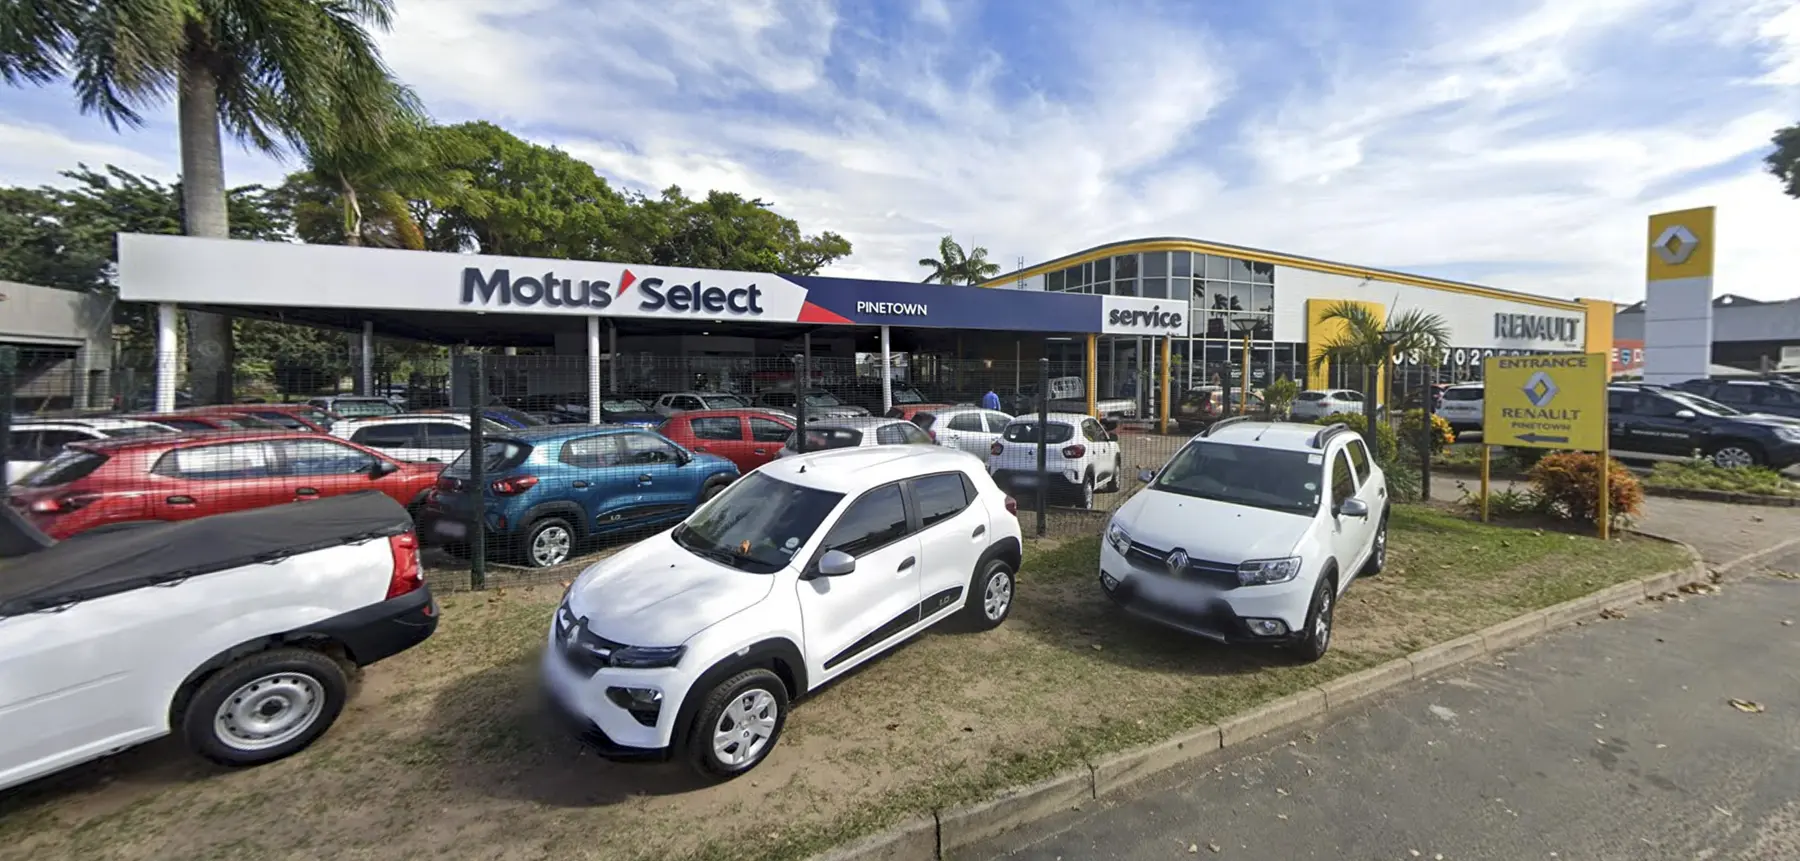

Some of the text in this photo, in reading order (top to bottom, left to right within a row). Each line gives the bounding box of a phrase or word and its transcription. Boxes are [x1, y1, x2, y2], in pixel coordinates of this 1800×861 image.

[461, 266, 764, 315] Motus Select
[857, 301, 927, 316] PINETOWN
[1108, 305, 1182, 328] service
[1494, 313, 1579, 342] RENAULT
[1498, 357, 1588, 369] ENTRANCE
[1502, 408, 1581, 420] RENAULT
[1511, 421, 1571, 432] PINETOWN
